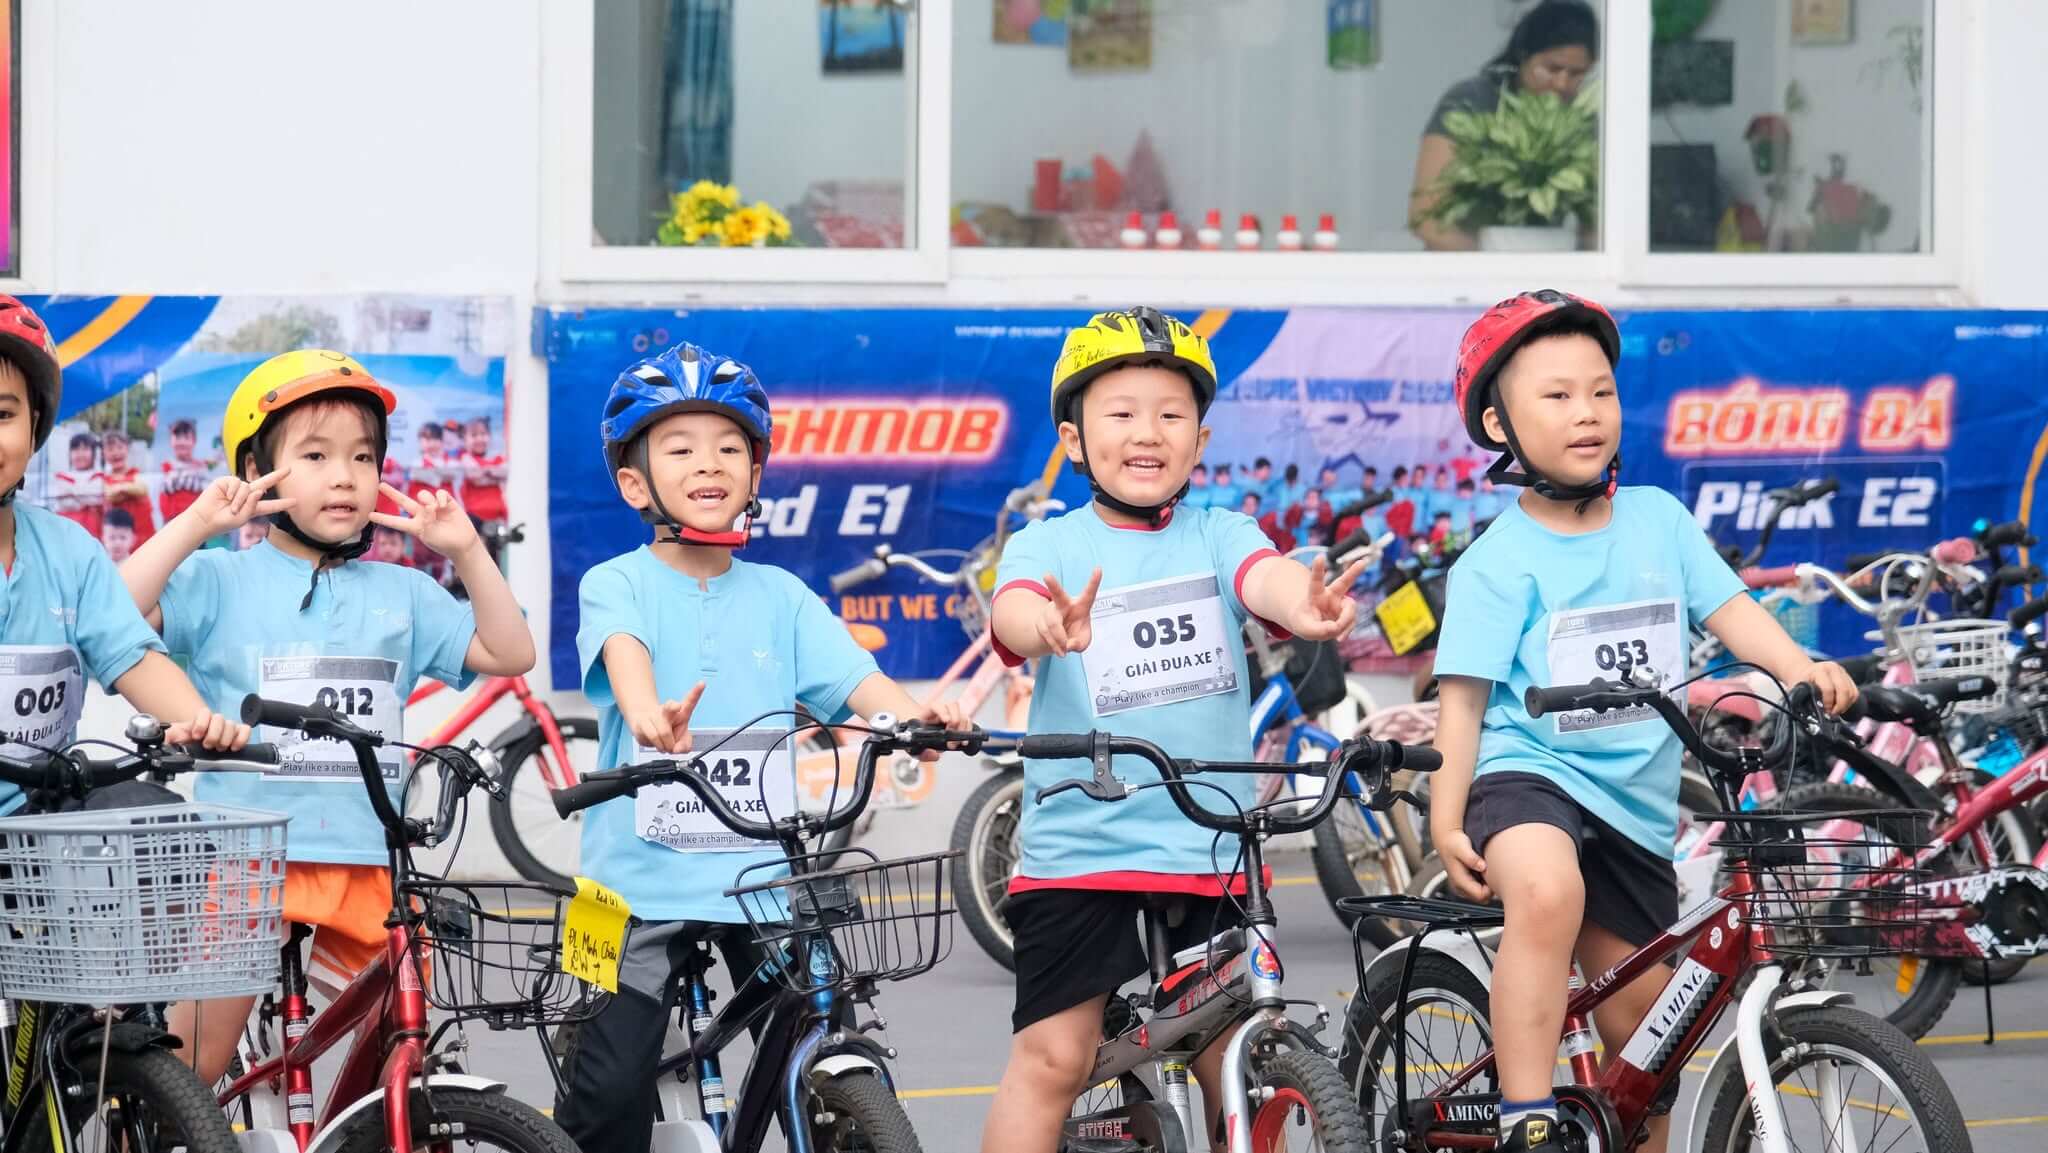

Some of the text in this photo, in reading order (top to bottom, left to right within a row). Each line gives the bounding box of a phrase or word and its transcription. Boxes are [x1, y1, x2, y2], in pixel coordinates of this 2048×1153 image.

[838, 485, 911, 536] E1
[1694, 478, 1937, 530] Pink E2
[842, 595, 892, 620] BUT
[900, 595, 938, 620] WE
[1133, 613, 1196, 649] 035
[1125, 651, 1212, 678] GIẢI ĐUA XE
[1595, 639, 1649, 670] 053
[14, 681, 66, 717] 003
[315, 686, 374, 716] 012
[1135, 691, 1152, 701] like
[1161, 683, 1200, 696] champion
[284, 762, 302, 772] Play
[305, 762, 322, 772] like
[332, 763, 361, 773] champ
[744, 800, 764, 812] XE
[661, 836, 679, 845] Play
[681, 835, 697, 844] like
[706, 835, 746, 844] champion
[1647, 965, 1704, 1041] XAMING
[1432, 1101, 1494, 1121] XAMING
[1078, 1119, 1123, 1138] STITCH
